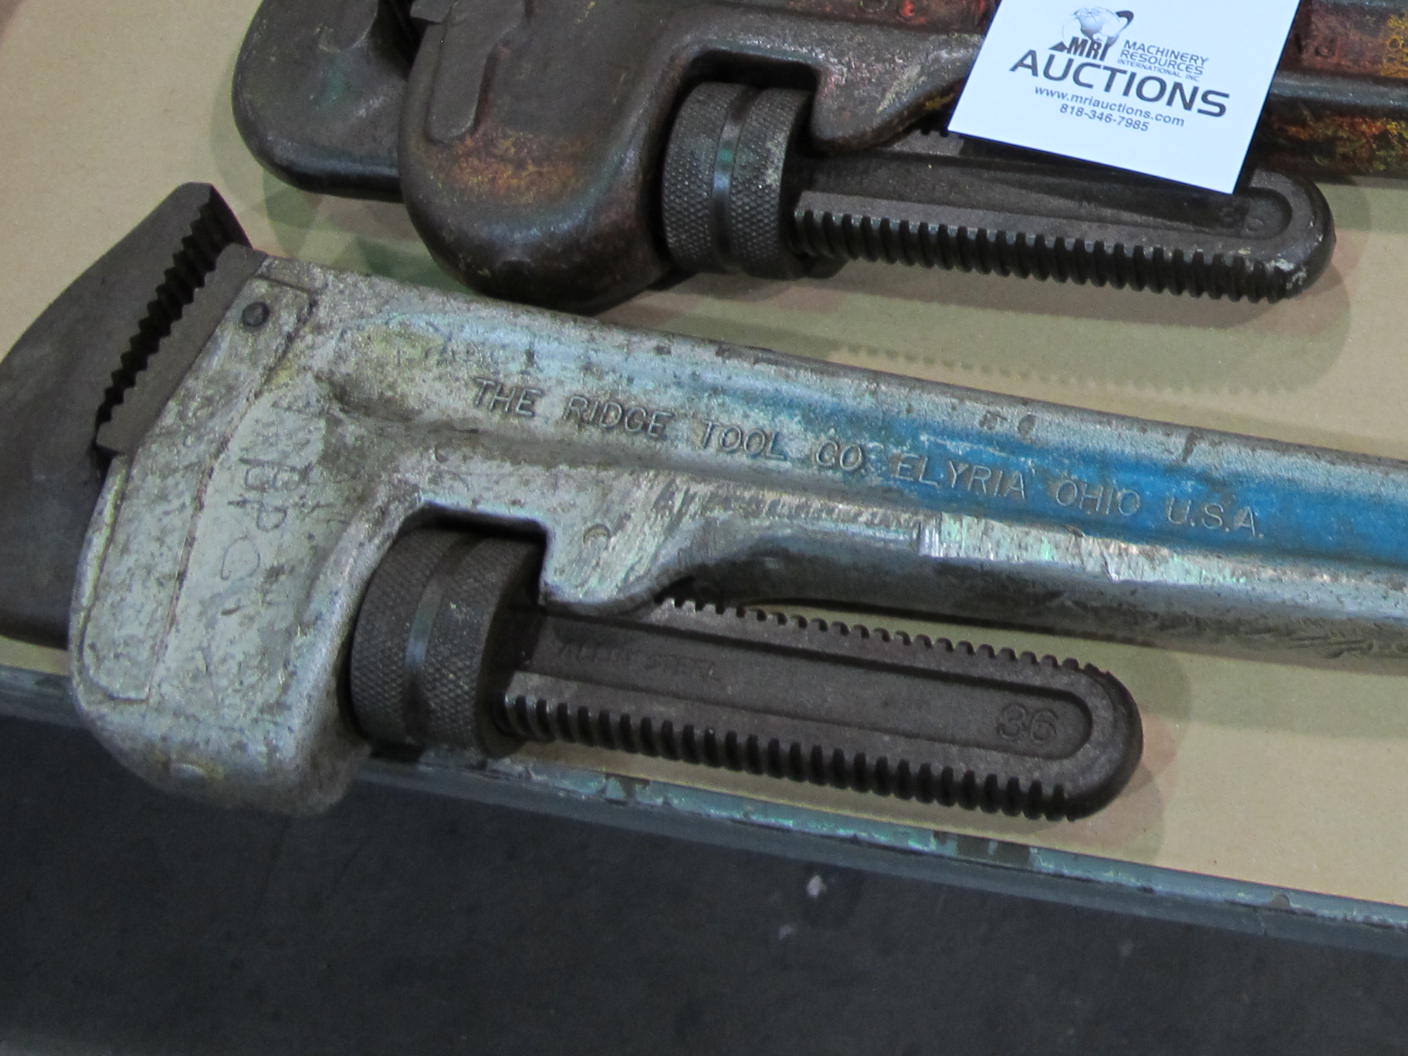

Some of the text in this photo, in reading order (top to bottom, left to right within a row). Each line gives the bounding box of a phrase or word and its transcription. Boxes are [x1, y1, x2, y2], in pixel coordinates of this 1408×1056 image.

[1066, 36, 1112, 62] MRI
[1120, 50, 1204, 76] RESOURCES
[1123, 40, 1209, 65] MACHINERY
[1009, 49, 1230, 118] AUCTIONS
[1034, 85, 1185, 127] www.mriauctions.com
[1059, 103, 1150, 133] 818-346-7985
[473, 376, 543, 418] THE
[562, 394, 674, 441] RIDGE
[702, 418, 788, 462] TOOL
[1056, 479, 1141, 517] OHIO
[1167, 495, 1264, 539] U.S.A.
